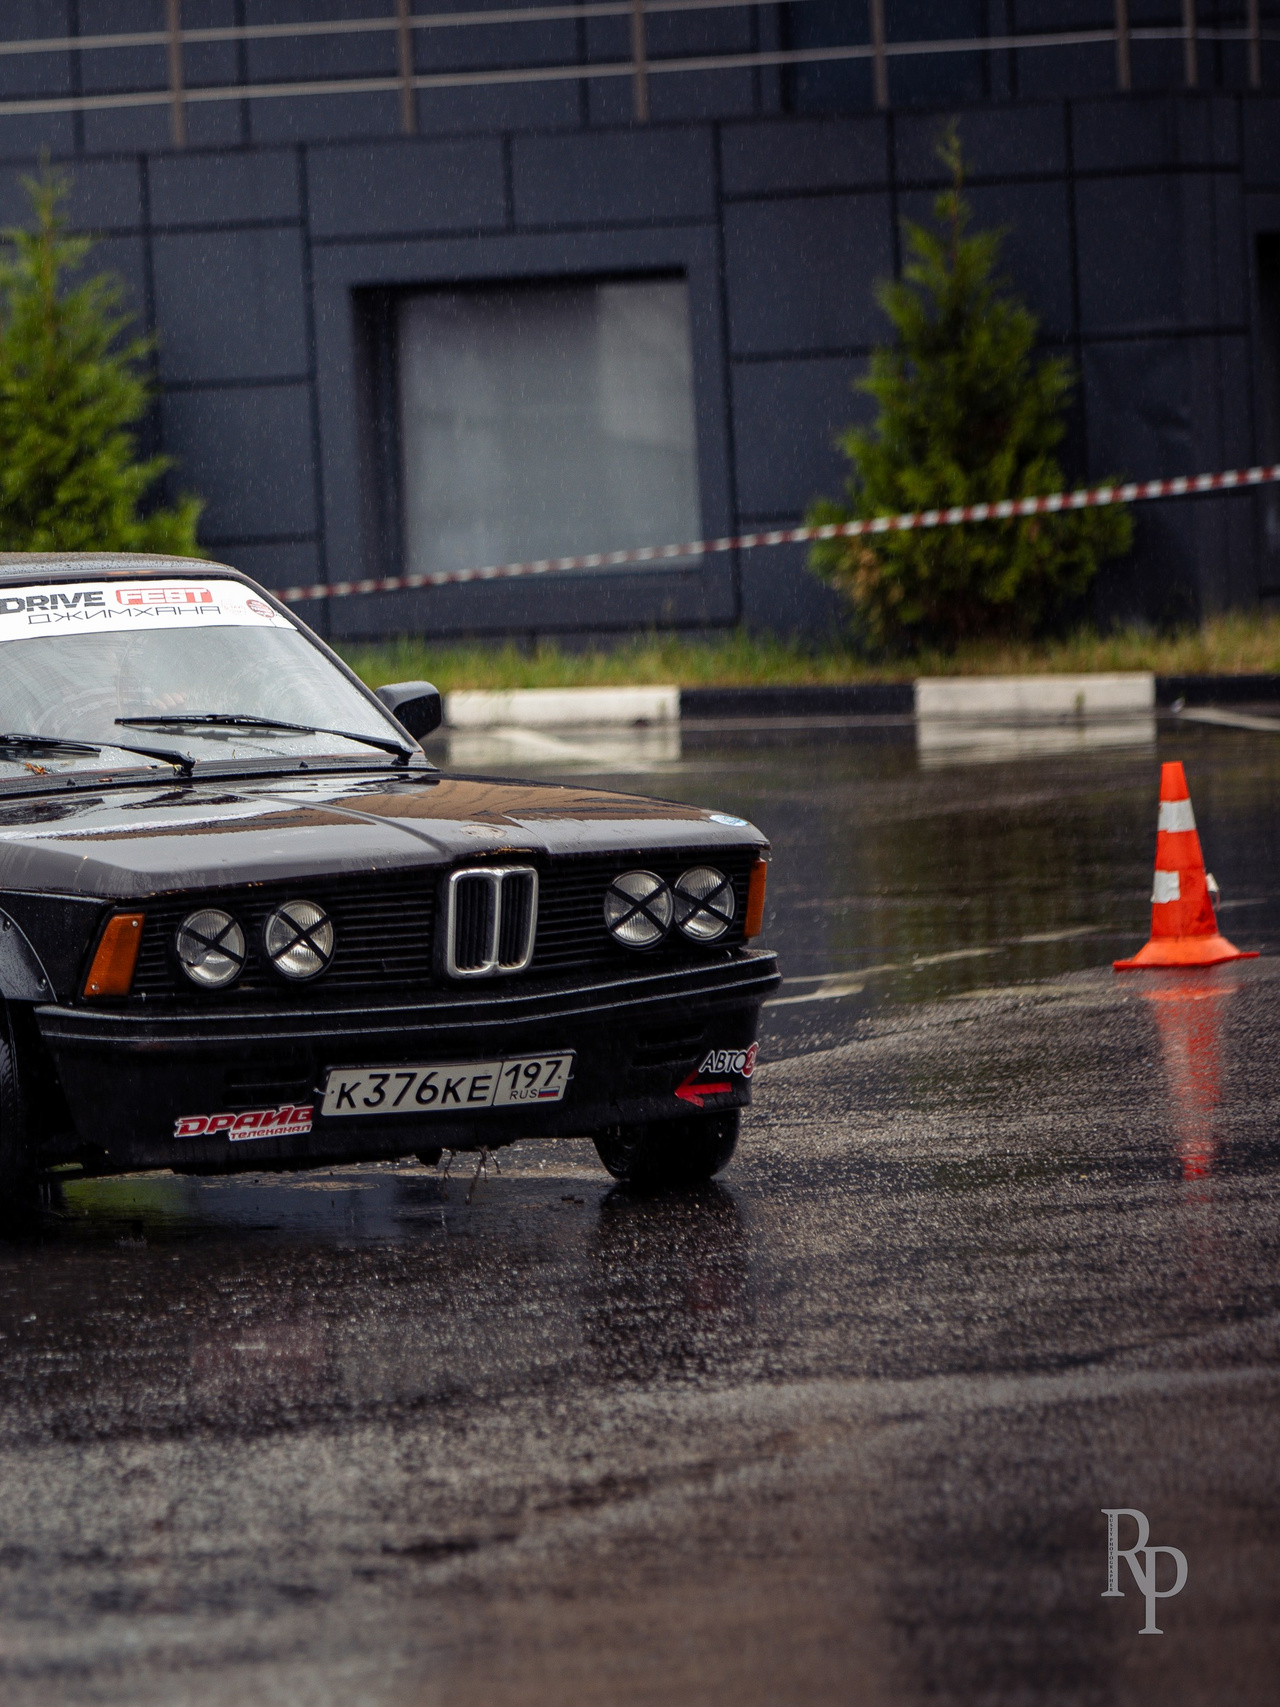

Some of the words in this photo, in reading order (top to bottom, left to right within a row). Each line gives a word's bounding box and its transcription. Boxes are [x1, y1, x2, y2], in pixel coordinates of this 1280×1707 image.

[27, 605, 222, 626] ДЖИМХАНА
[334, 1071, 493, 1110] К376КЕ
[504, 1060, 563, 1090] 197
[509, 1088, 538, 1100] RUS
[177, 1106, 313, 1135] ДРАЙВ
